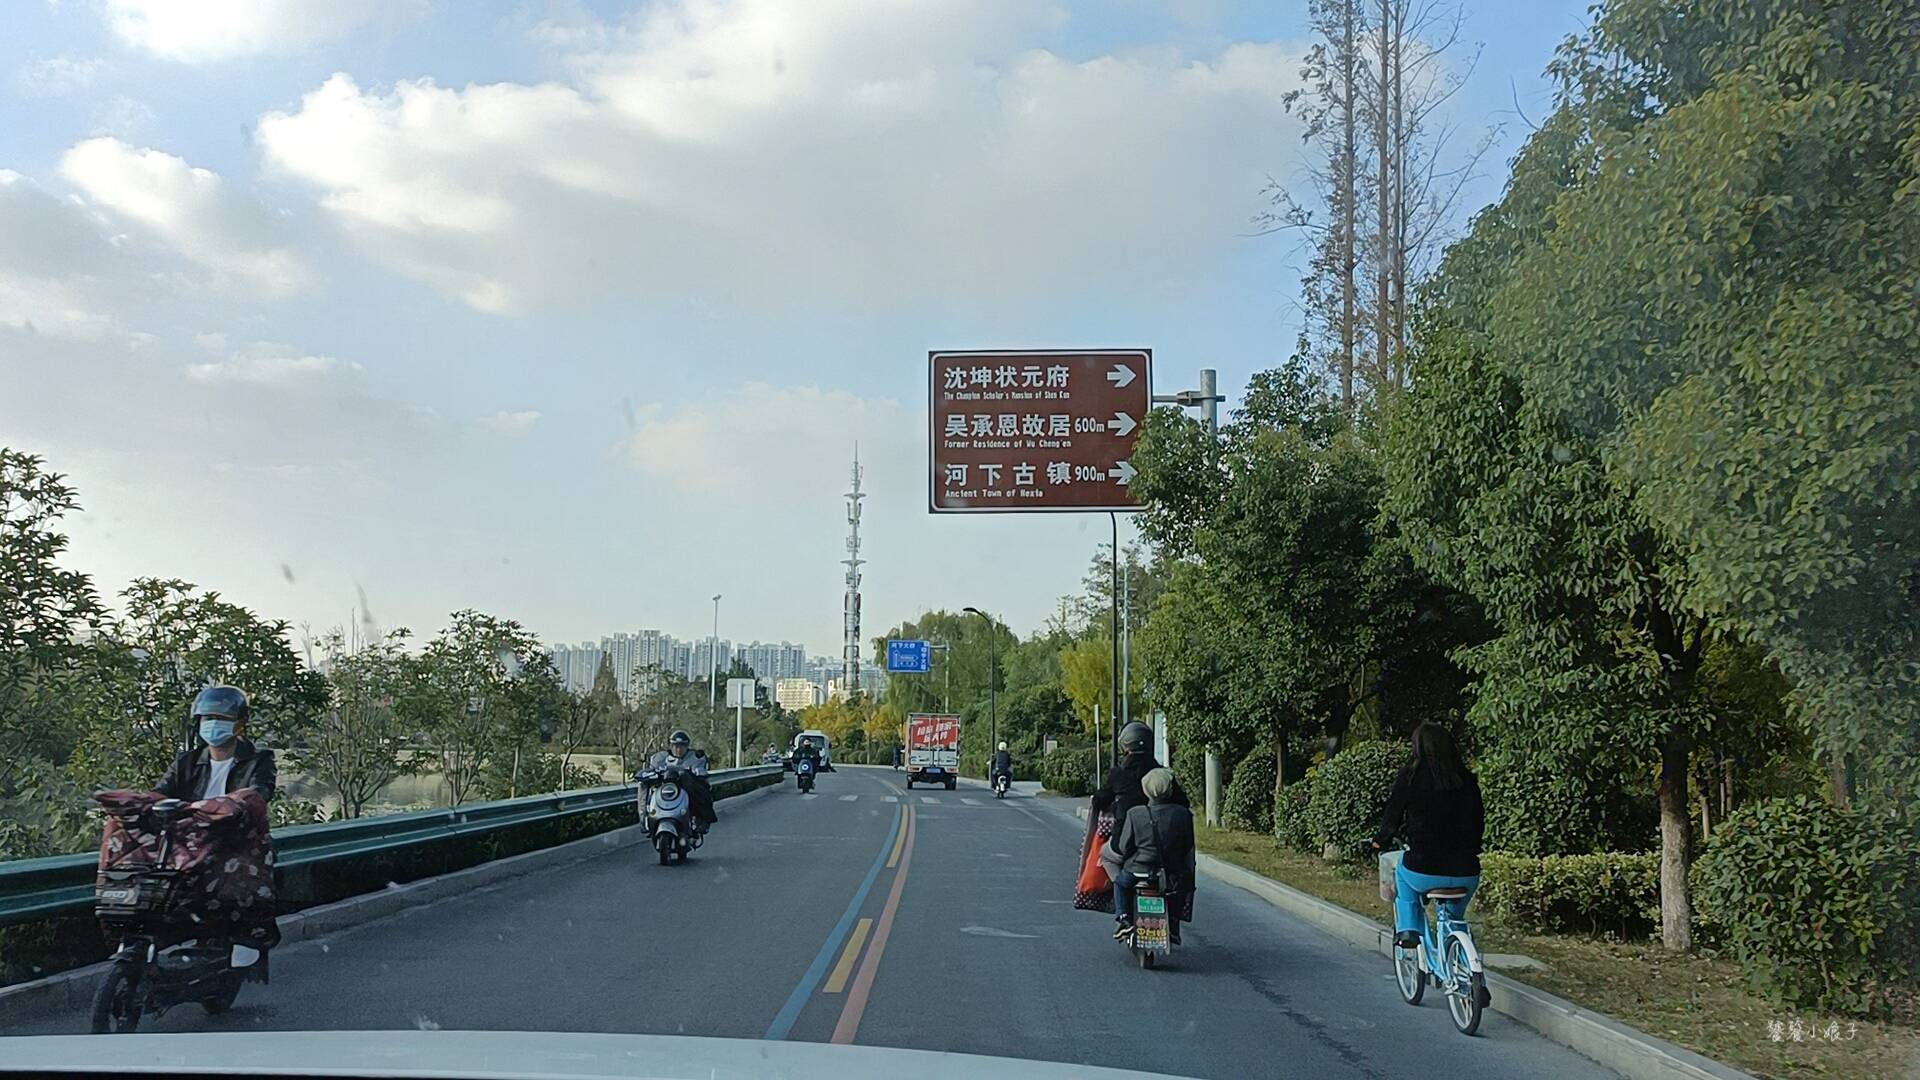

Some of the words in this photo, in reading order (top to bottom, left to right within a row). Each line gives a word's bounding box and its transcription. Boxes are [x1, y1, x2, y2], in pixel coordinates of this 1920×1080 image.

[943, 364, 1070, 389] 沈坤状元府
[944, 391, 954, 400] The
[1035, 391, 1042, 399] of
[944, 414, 1071, 437] 吴承恩故居
[1074, 417, 1105, 433] 600m
[944, 440, 970, 448] Former
[973, 440, 1011, 448] Residence
[1013, 440, 1023, 448] of
[1026, 440, 1036, 448] Wu
[944, 462, 1071, 486] 河下古镇
[1075, 465, 1106, 482] 900m
[945, 489, 978, 498] Ancient
[982, 489, 1002, 497] Town
[1006, 489, 1016, 498] of
[1020, 488, 1044, 497] Hexia
